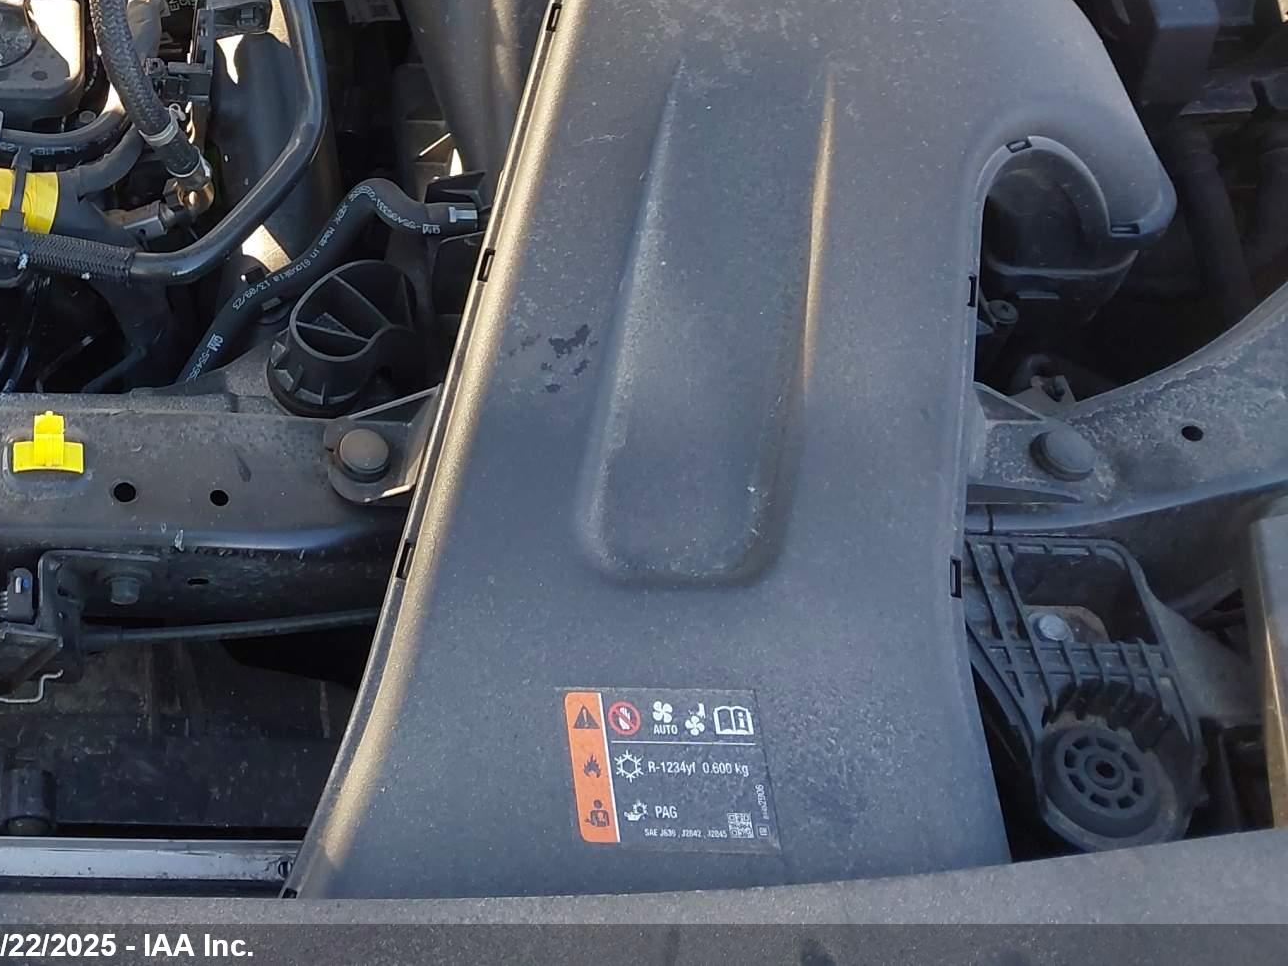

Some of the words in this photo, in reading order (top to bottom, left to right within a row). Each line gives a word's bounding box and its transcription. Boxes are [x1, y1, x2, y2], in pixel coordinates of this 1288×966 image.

[310, 249, 321, 259] in
[653, 724, 678, 735] AUTO
[647, 760, 696, 776] R-1234yf
[702, 761, 733, 774] 0.600
[735, 763, 749, 778] kg
[654, 805, 678, 819] PAG
[644, 828, 658, 837] SAE
